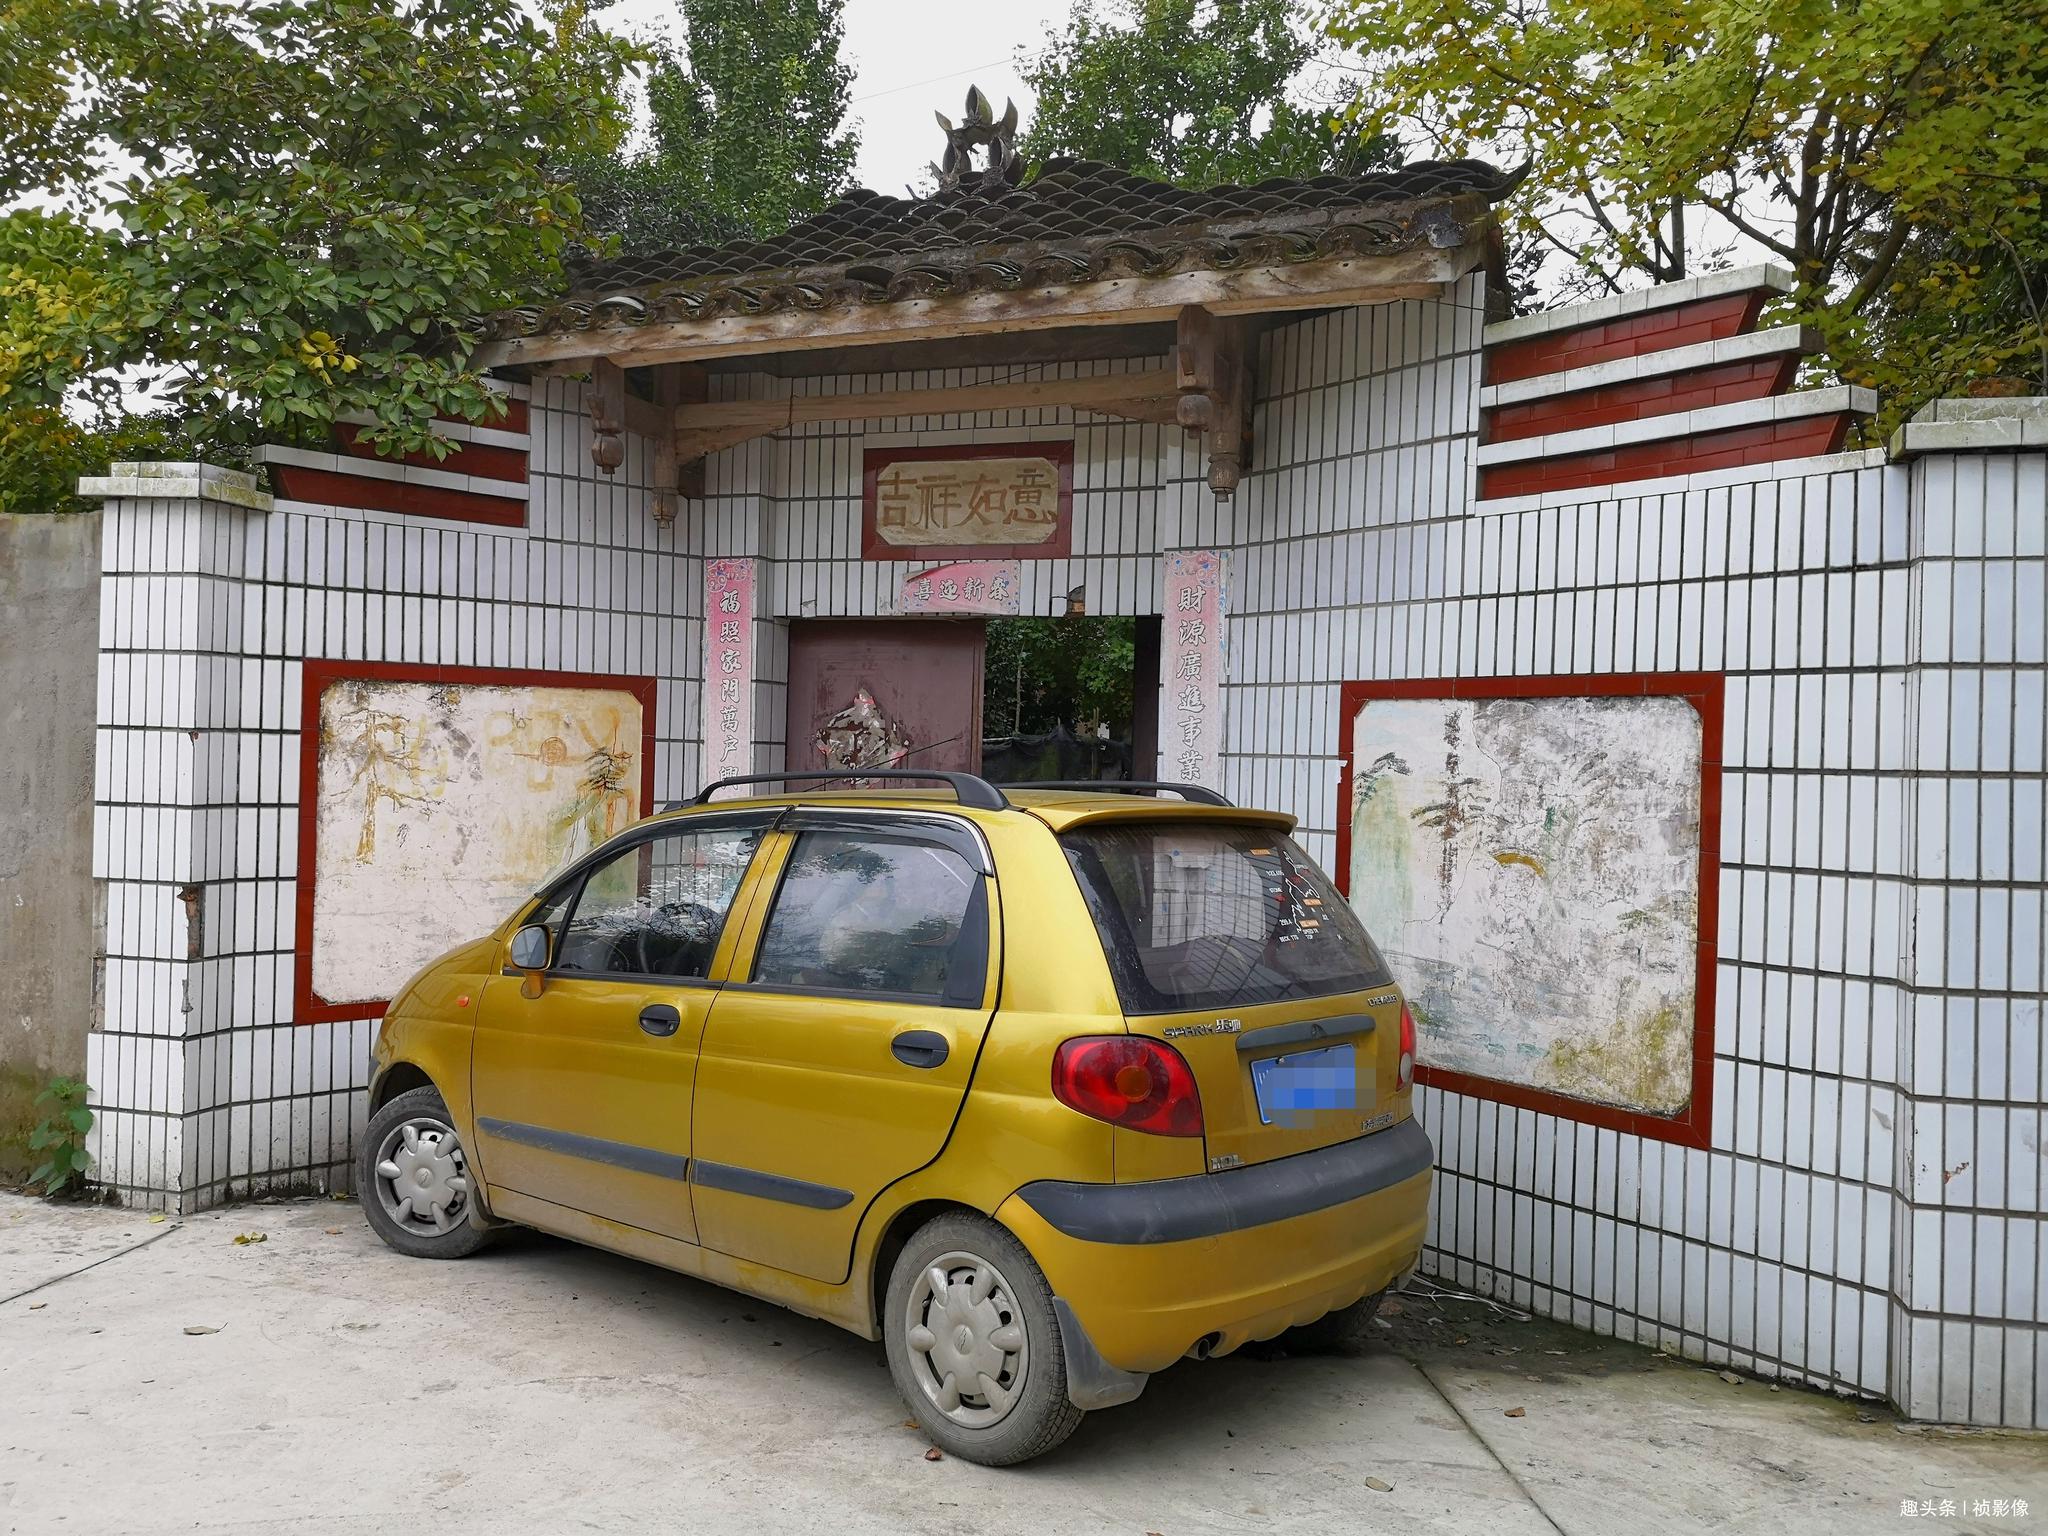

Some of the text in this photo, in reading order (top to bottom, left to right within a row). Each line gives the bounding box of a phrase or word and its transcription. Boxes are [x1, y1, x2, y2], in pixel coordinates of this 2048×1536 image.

[876, 468, 1058, 529] 吉祥如意
[914, 576, 1009, 601] 喜迎新春
[1176, 585, 1207, 786] 財源廣進事業
[1163, 1024, 1214, 1039] SPARK
